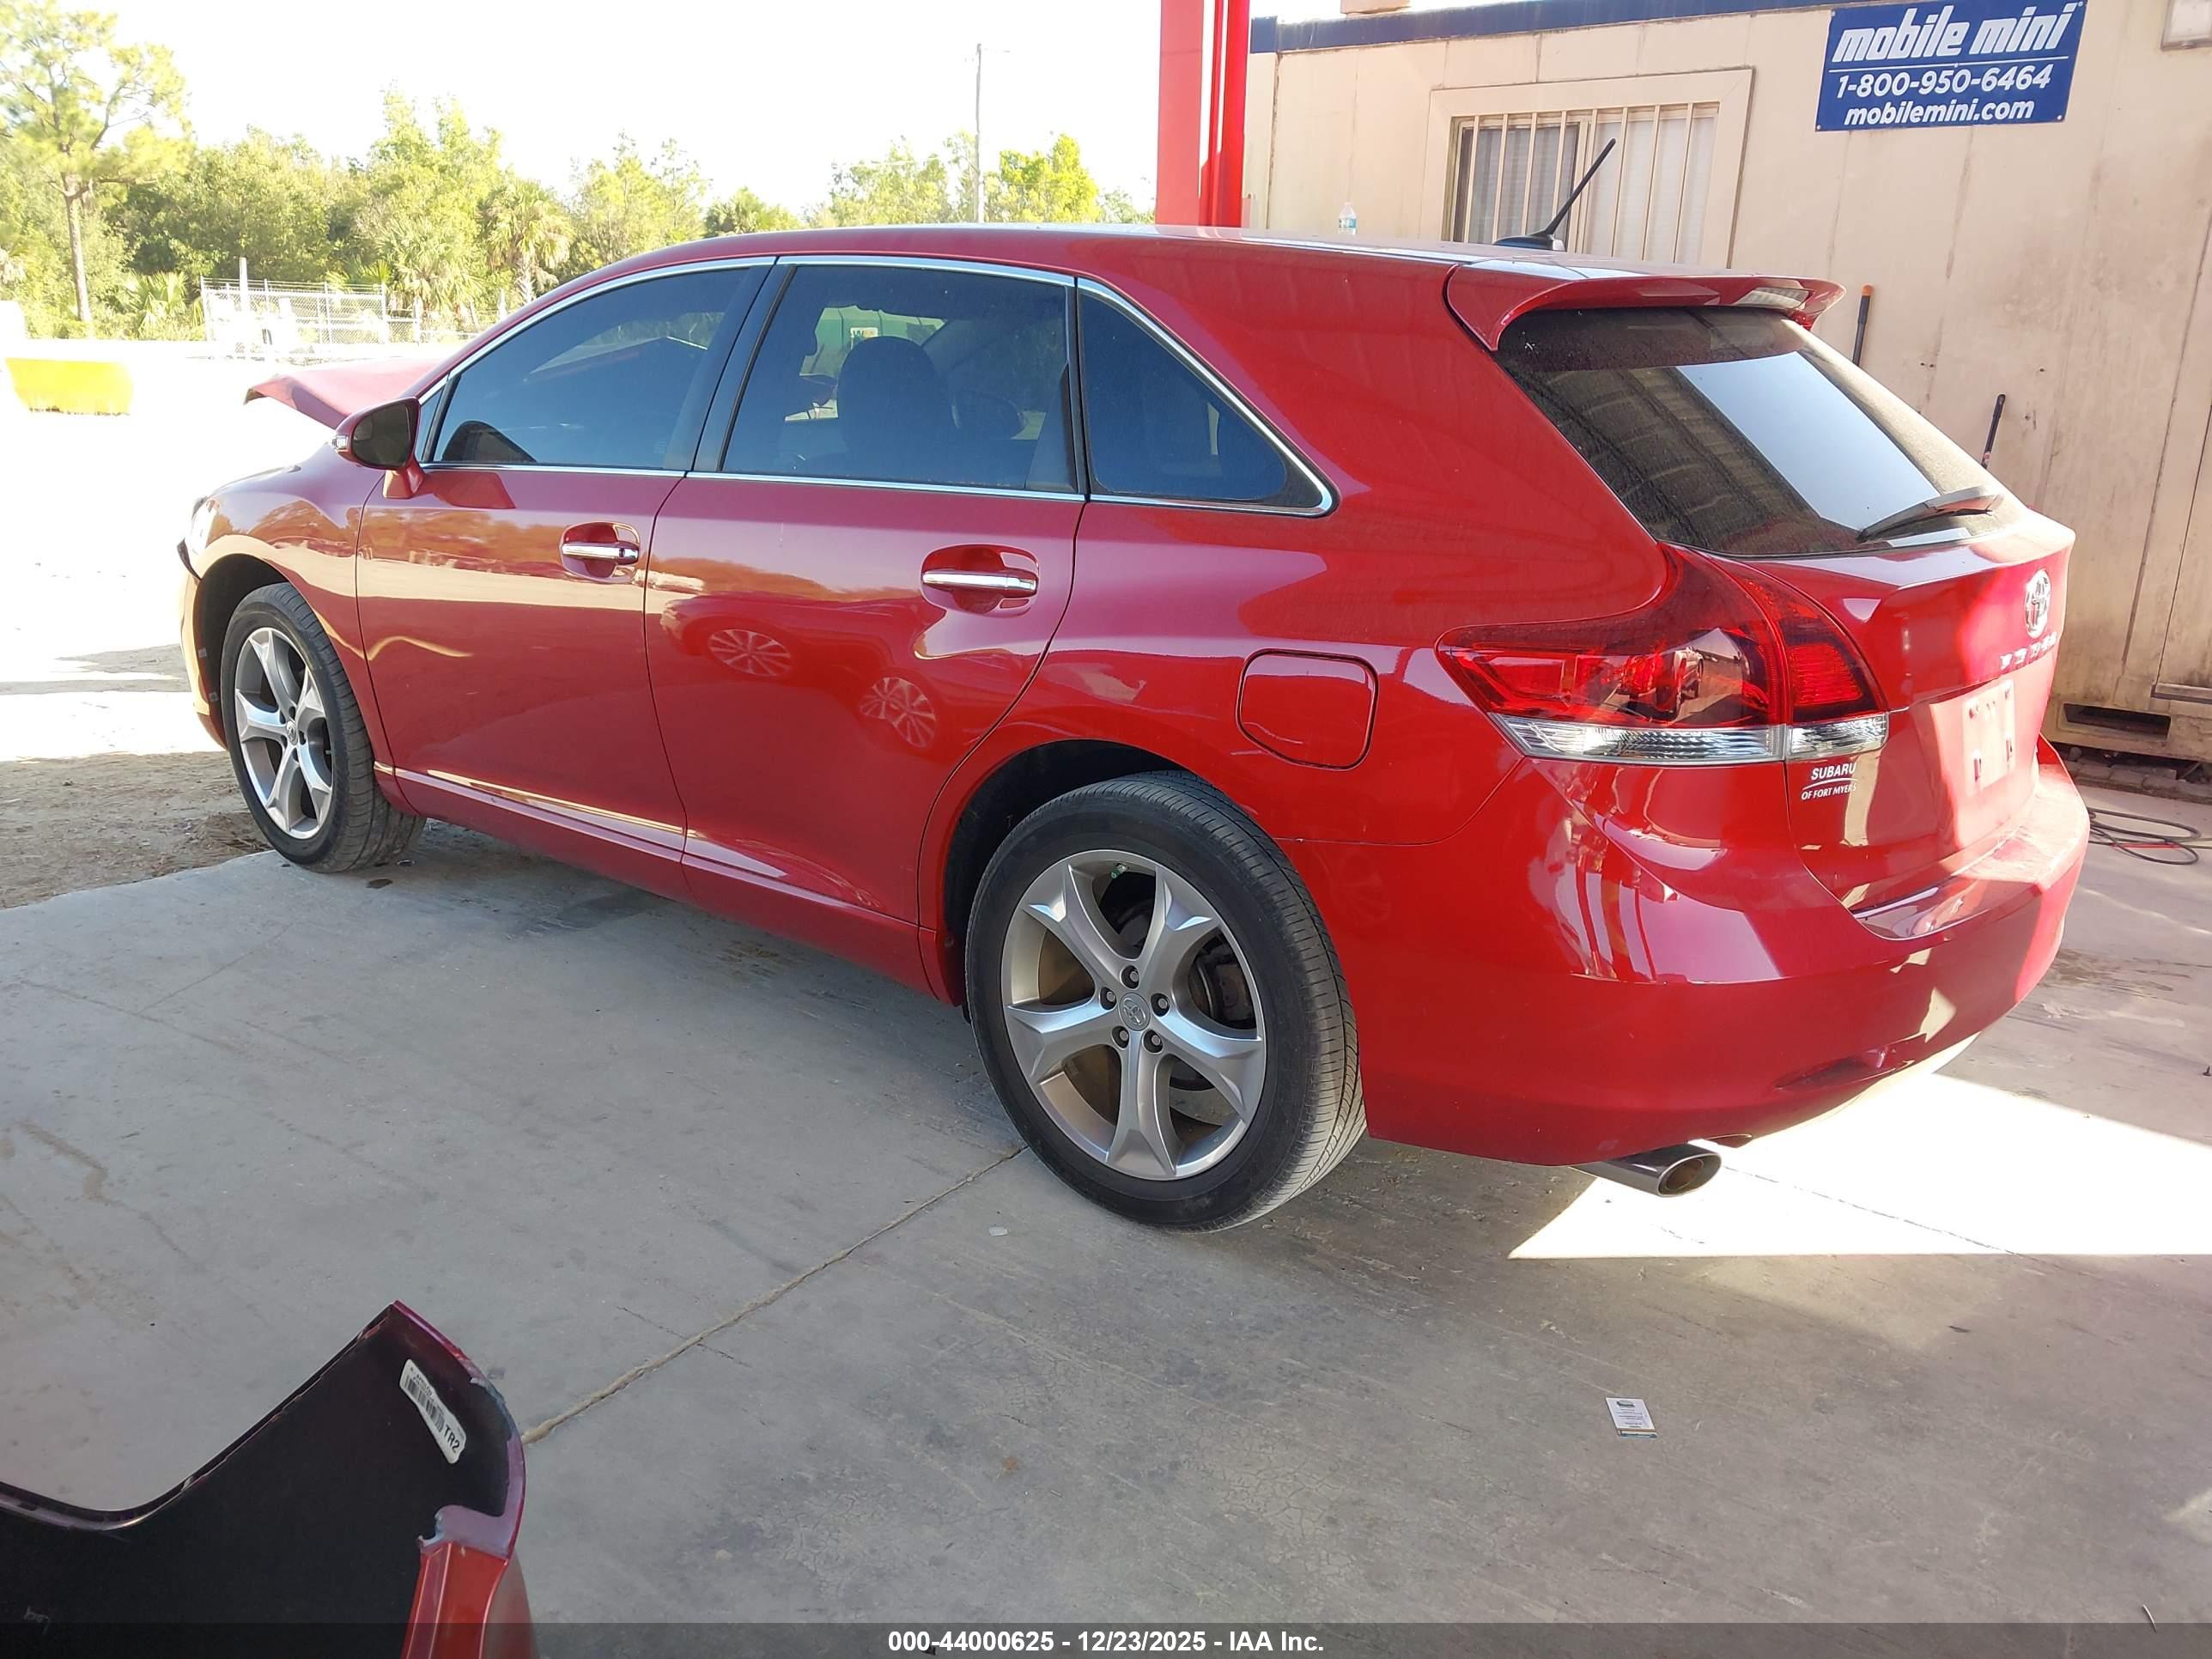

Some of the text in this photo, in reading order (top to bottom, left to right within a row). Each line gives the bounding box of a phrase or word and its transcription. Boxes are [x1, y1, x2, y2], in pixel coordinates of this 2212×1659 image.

[1832, 2, 2078, 63] mobile mini
[1836, 64, 2054, 99] 1-800-950-6464
[1844, 97, 2035, 126] mobilemini.com
[1810, 762, 1856, 781] SUBARU
[1801, 790, 1814, 800] OF
[1813, 787, 1832, 799] FORT
[443, 1424, 460, 1454] TR2
